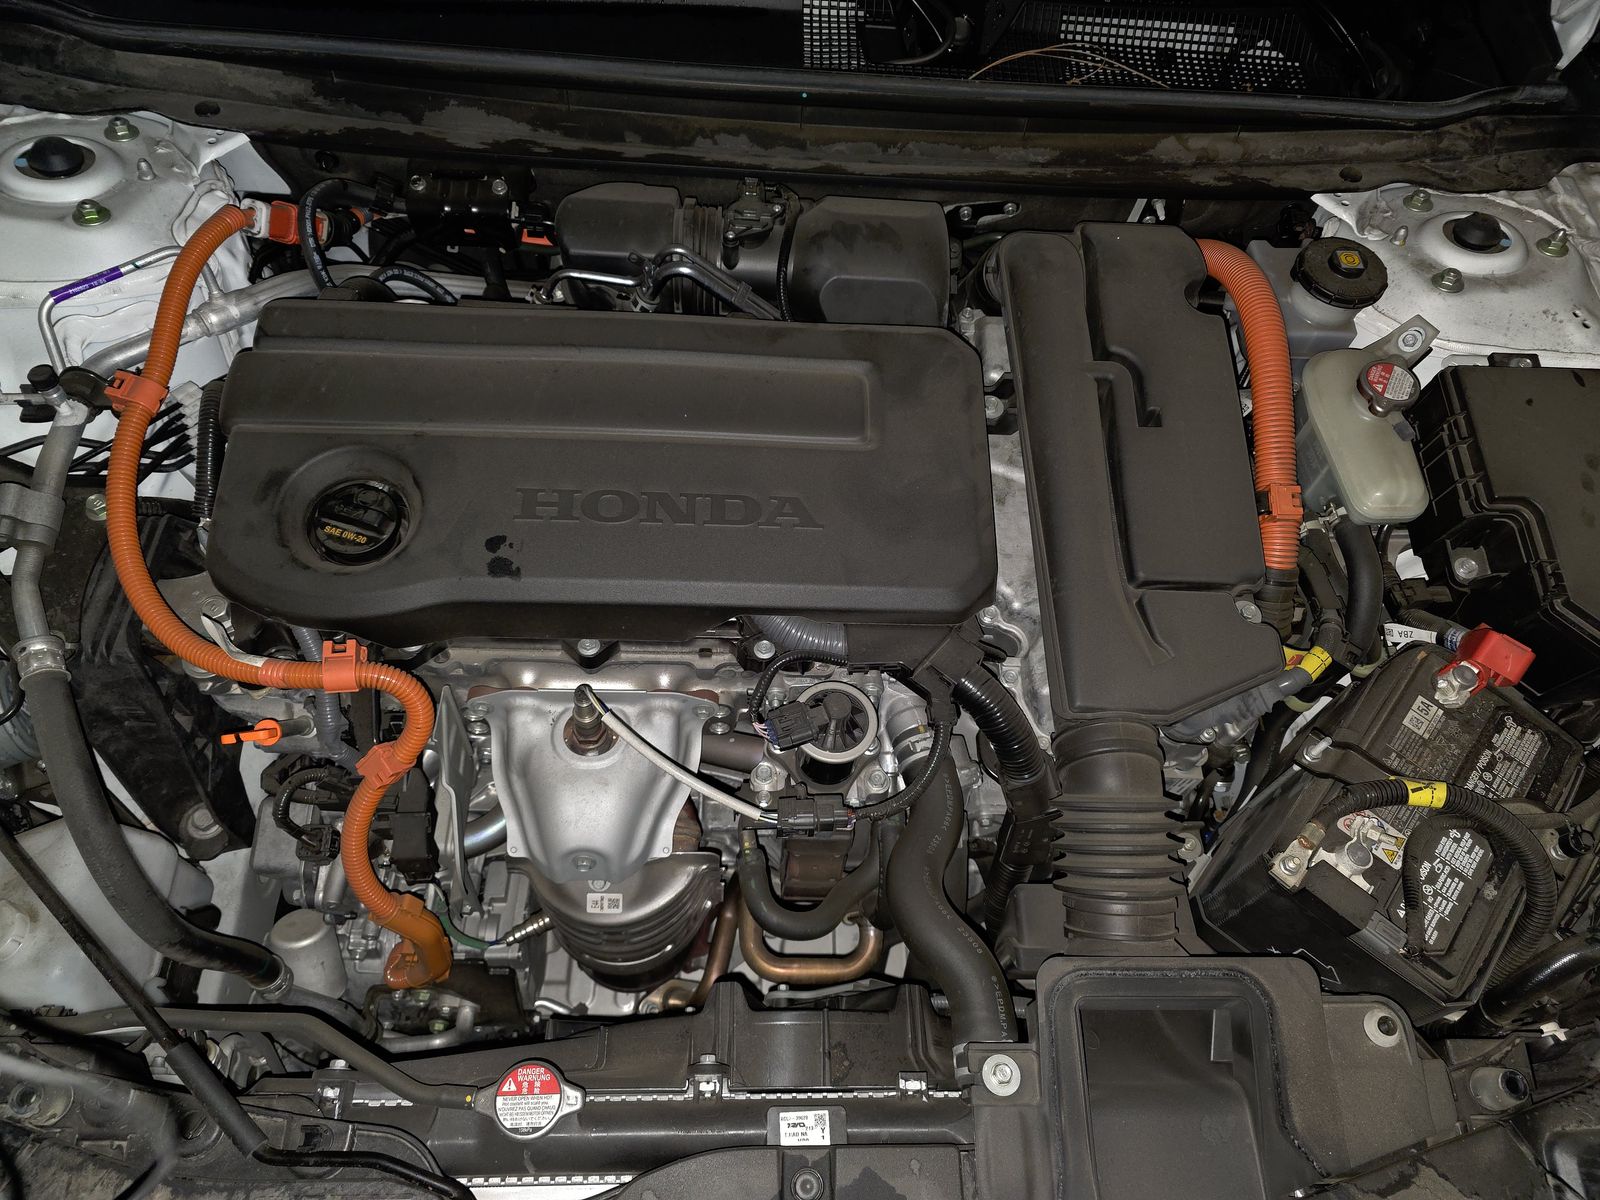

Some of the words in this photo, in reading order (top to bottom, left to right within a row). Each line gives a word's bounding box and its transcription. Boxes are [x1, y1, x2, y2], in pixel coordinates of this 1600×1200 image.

[513, 487, 824, 529] HONDA
[324, 526, 342, 536] SAE
[342, 531, 368, 544] 0W-20
[1417, 700, 1433, 717] 5A
[517, 1068, 545, 1076] DANGER
